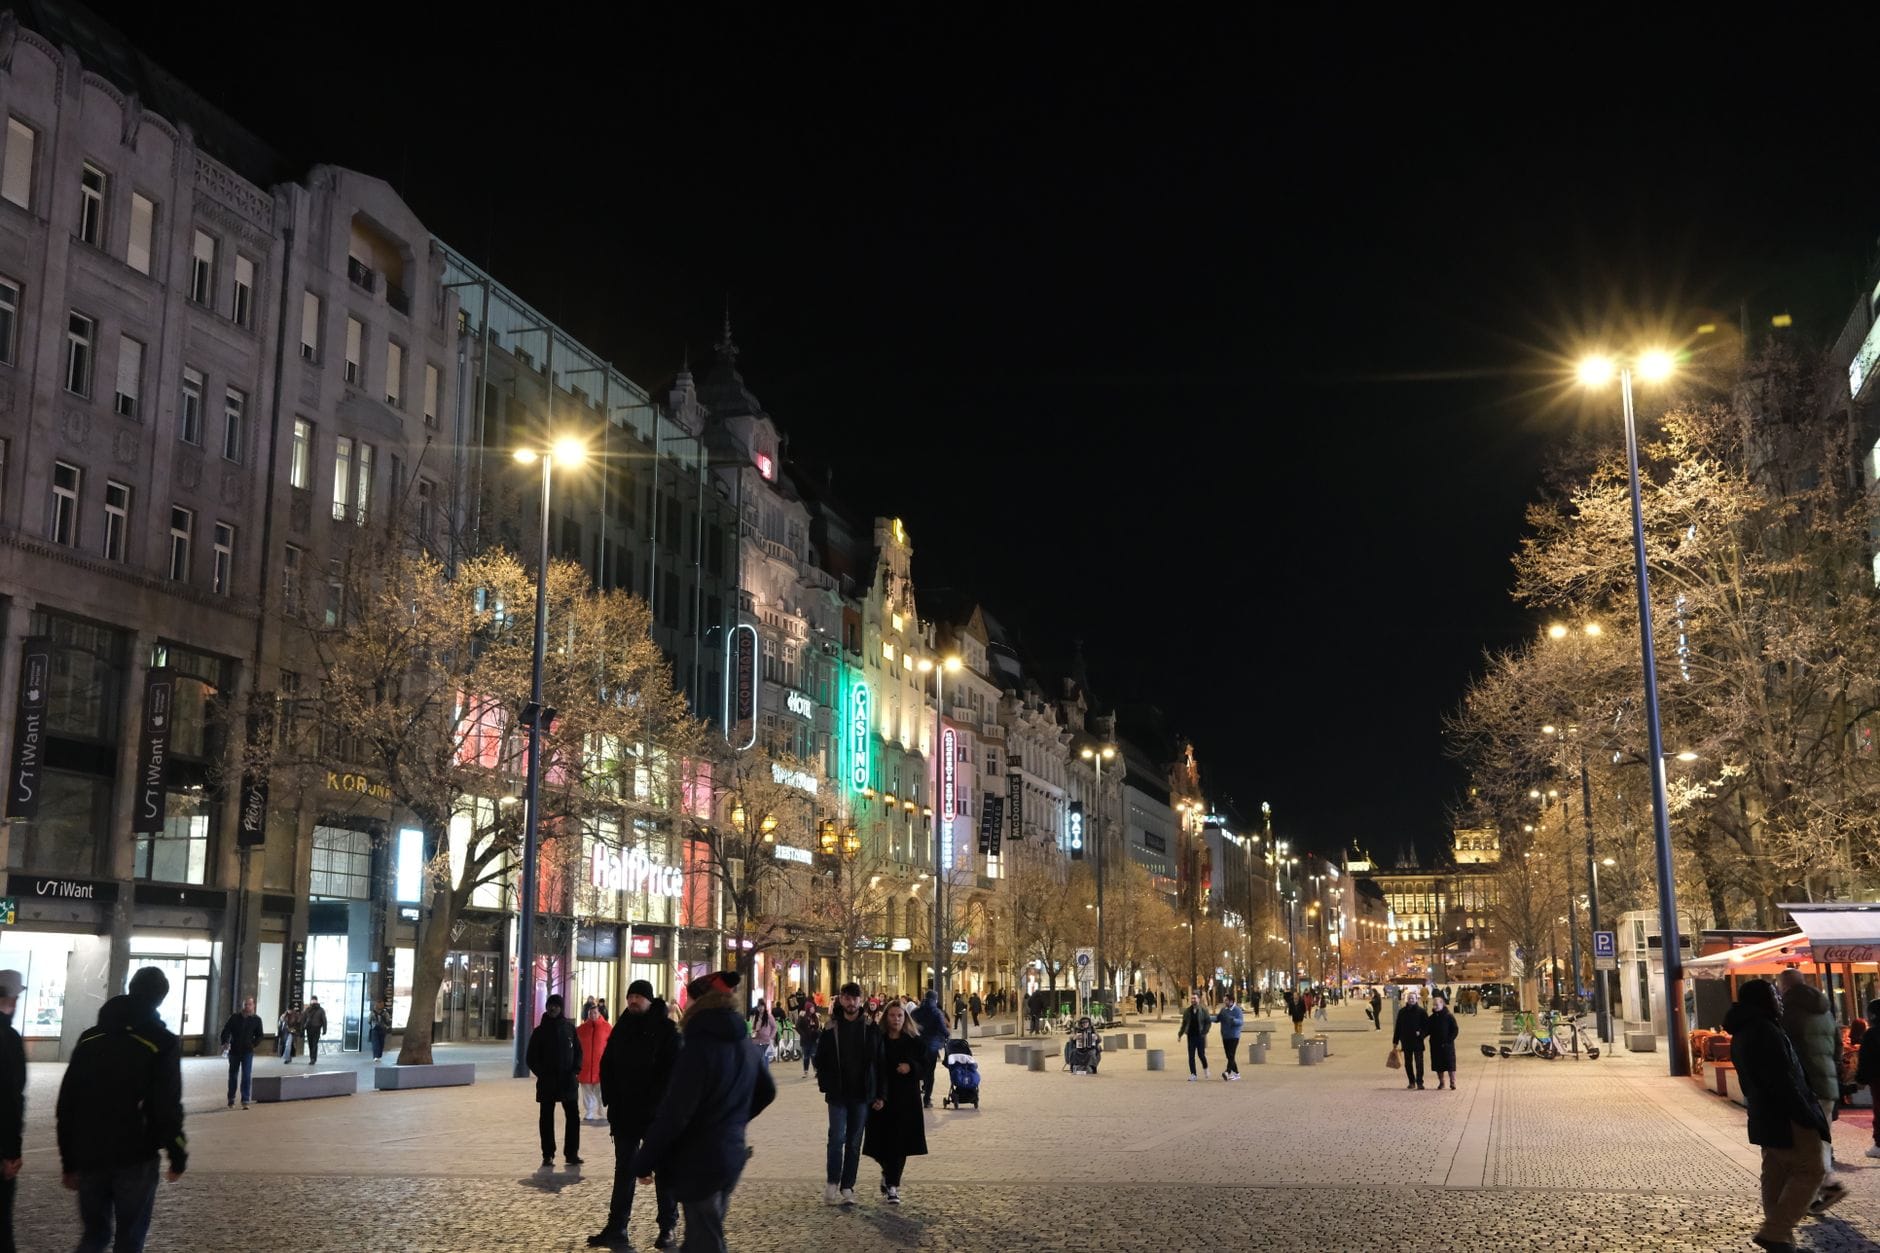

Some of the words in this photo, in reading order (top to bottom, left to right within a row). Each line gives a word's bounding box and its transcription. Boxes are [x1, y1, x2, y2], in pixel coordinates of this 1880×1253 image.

[21, 713, 40, 767] iWant
[147, 737, 164, 786] iWant
[855, 690, 867, 783] CASINO
[991, 805, 1002, 851] RESERVED
[1011, 775, 1021, 837] McDonald's
[60, 880, 94, 899] iWant
[592, 841, 683, 899] HalfPrice
[1598, 935, 1610, 950] P
